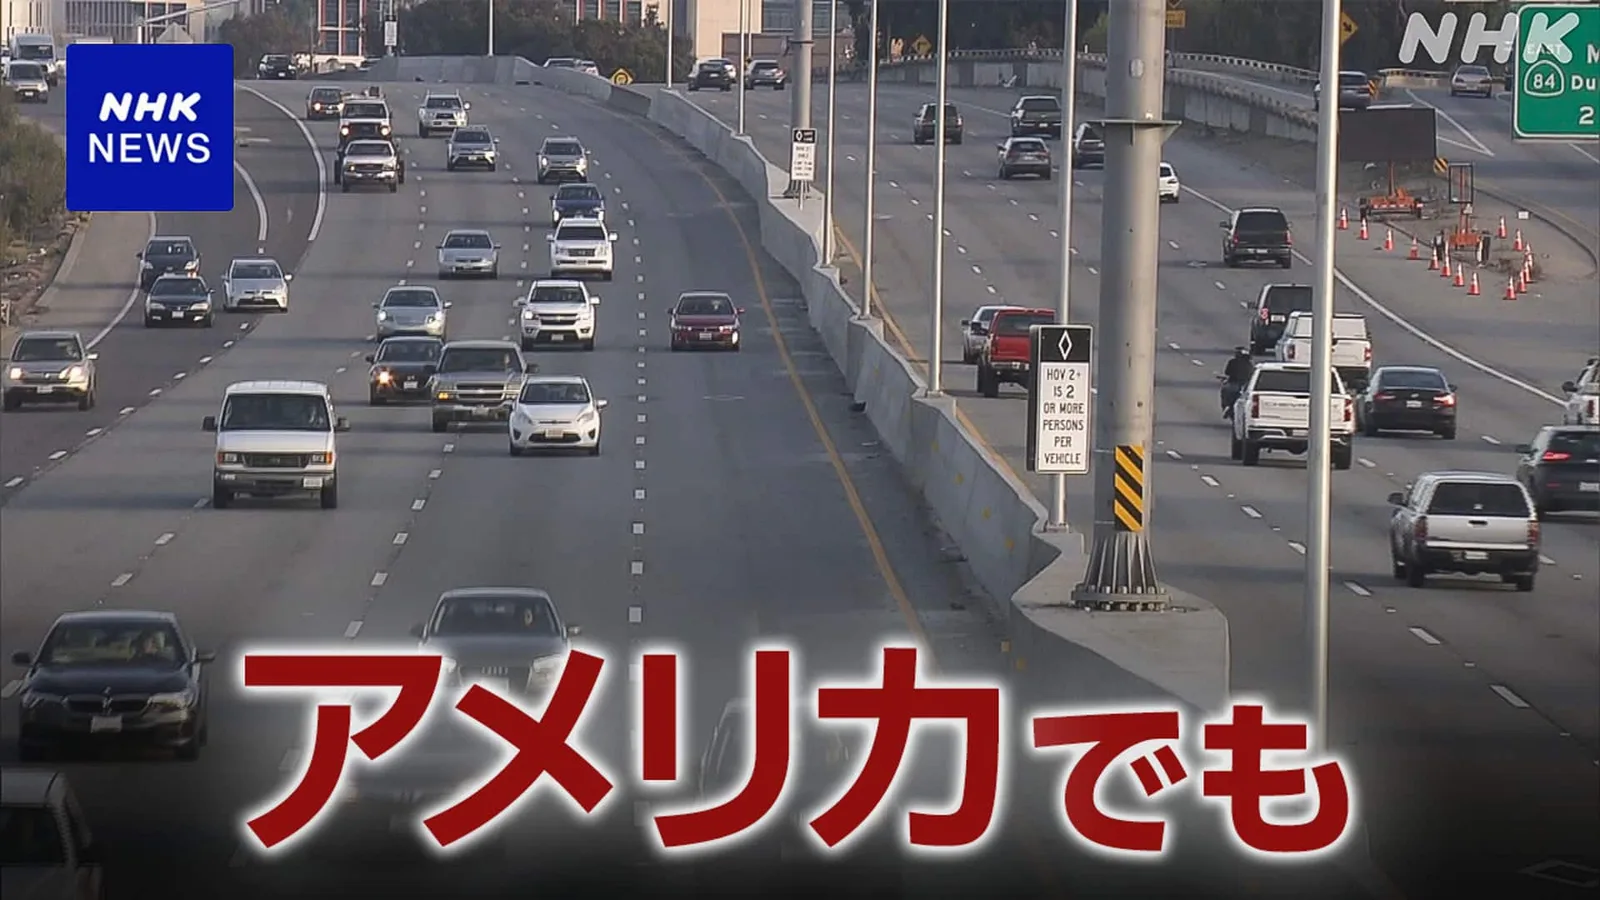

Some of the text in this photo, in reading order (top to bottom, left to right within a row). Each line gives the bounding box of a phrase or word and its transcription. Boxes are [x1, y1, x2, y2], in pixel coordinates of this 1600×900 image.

[1533, 73, 1556, 90] 84
[1571, 74, 1597, 91] Du
[1579, 105, 1595, 125] 2
[1047, 368, 1066, 380] HOV
[1053, 384, 1075, 399] IS 2
[1043, 402, 1085, 415] OR MORE
[1043, 419, 1084, 431] PERSONS
[1054, 436, 1072, 448] PER
[1044, 452, 1082, 465] VEHICLE
